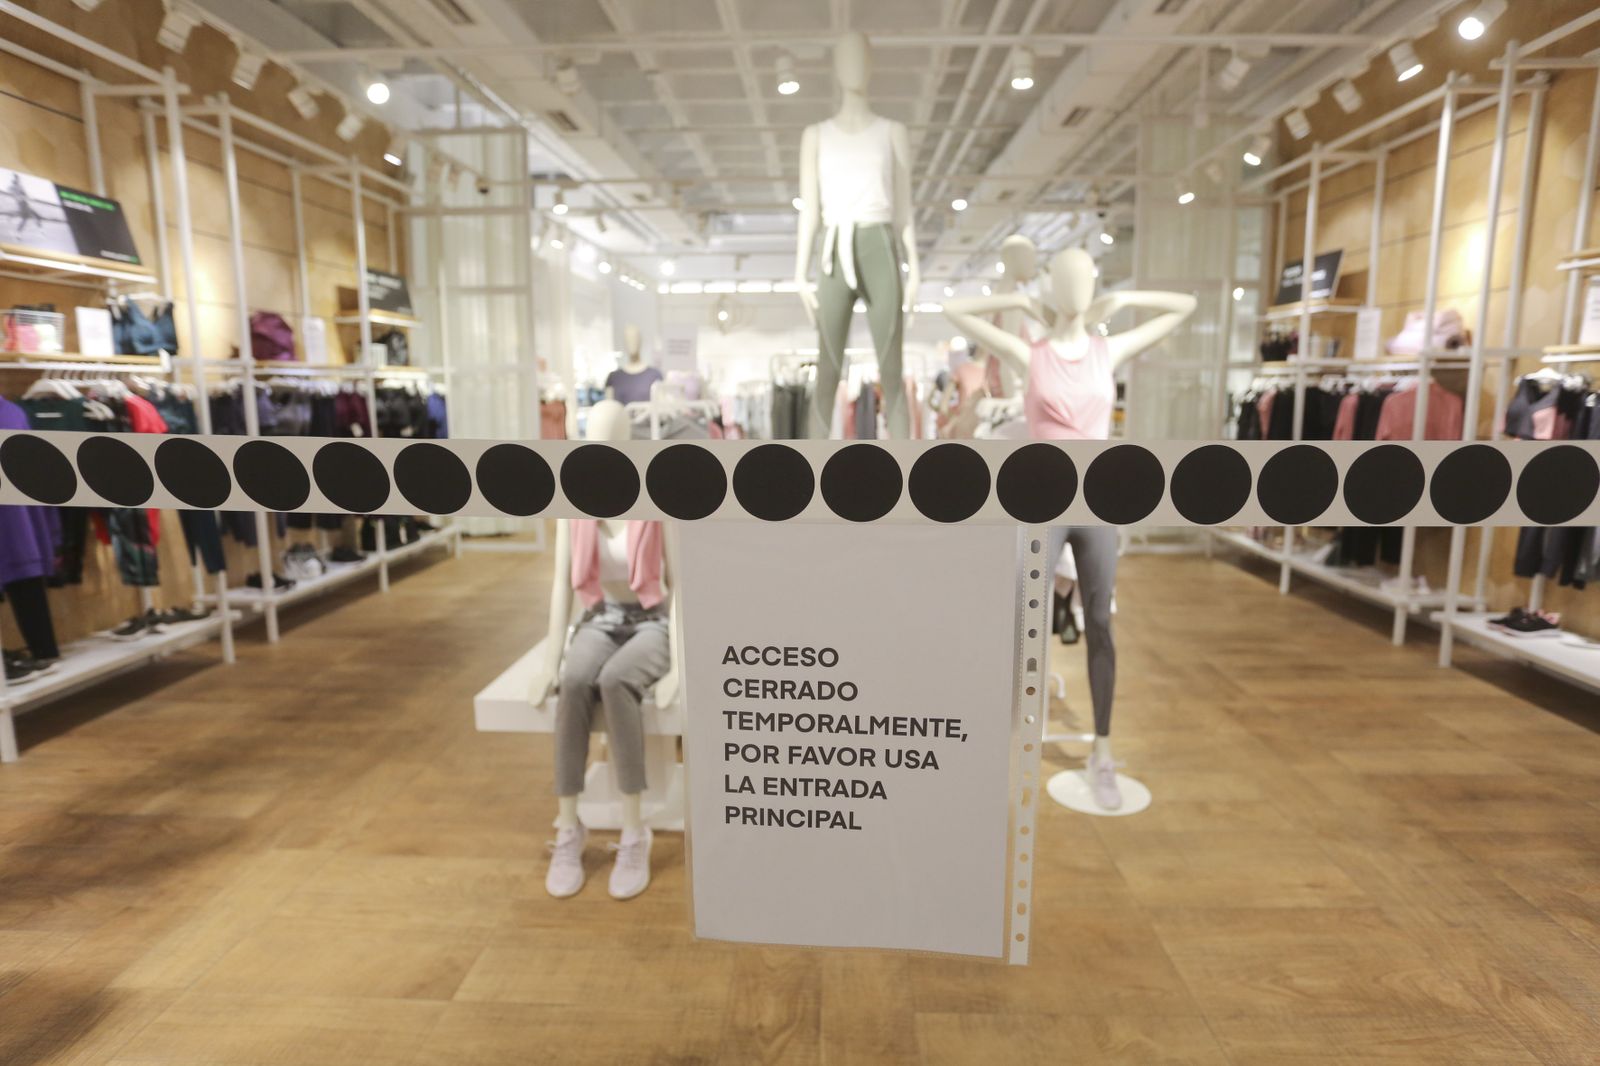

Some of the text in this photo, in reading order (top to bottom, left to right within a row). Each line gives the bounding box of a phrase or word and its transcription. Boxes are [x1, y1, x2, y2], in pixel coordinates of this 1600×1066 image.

[721, 645, 840, 668] ACCESO
[722, 677, 859, 702] CERRADO
[722, 710, 968, 742] TEMPORALMENTE,
[724, 742, 940, 771] POR FAVOR USA
[724, 774, 888, 800] LA ENTRADA
[725, 805, 863, 831] PRINCIPAL
